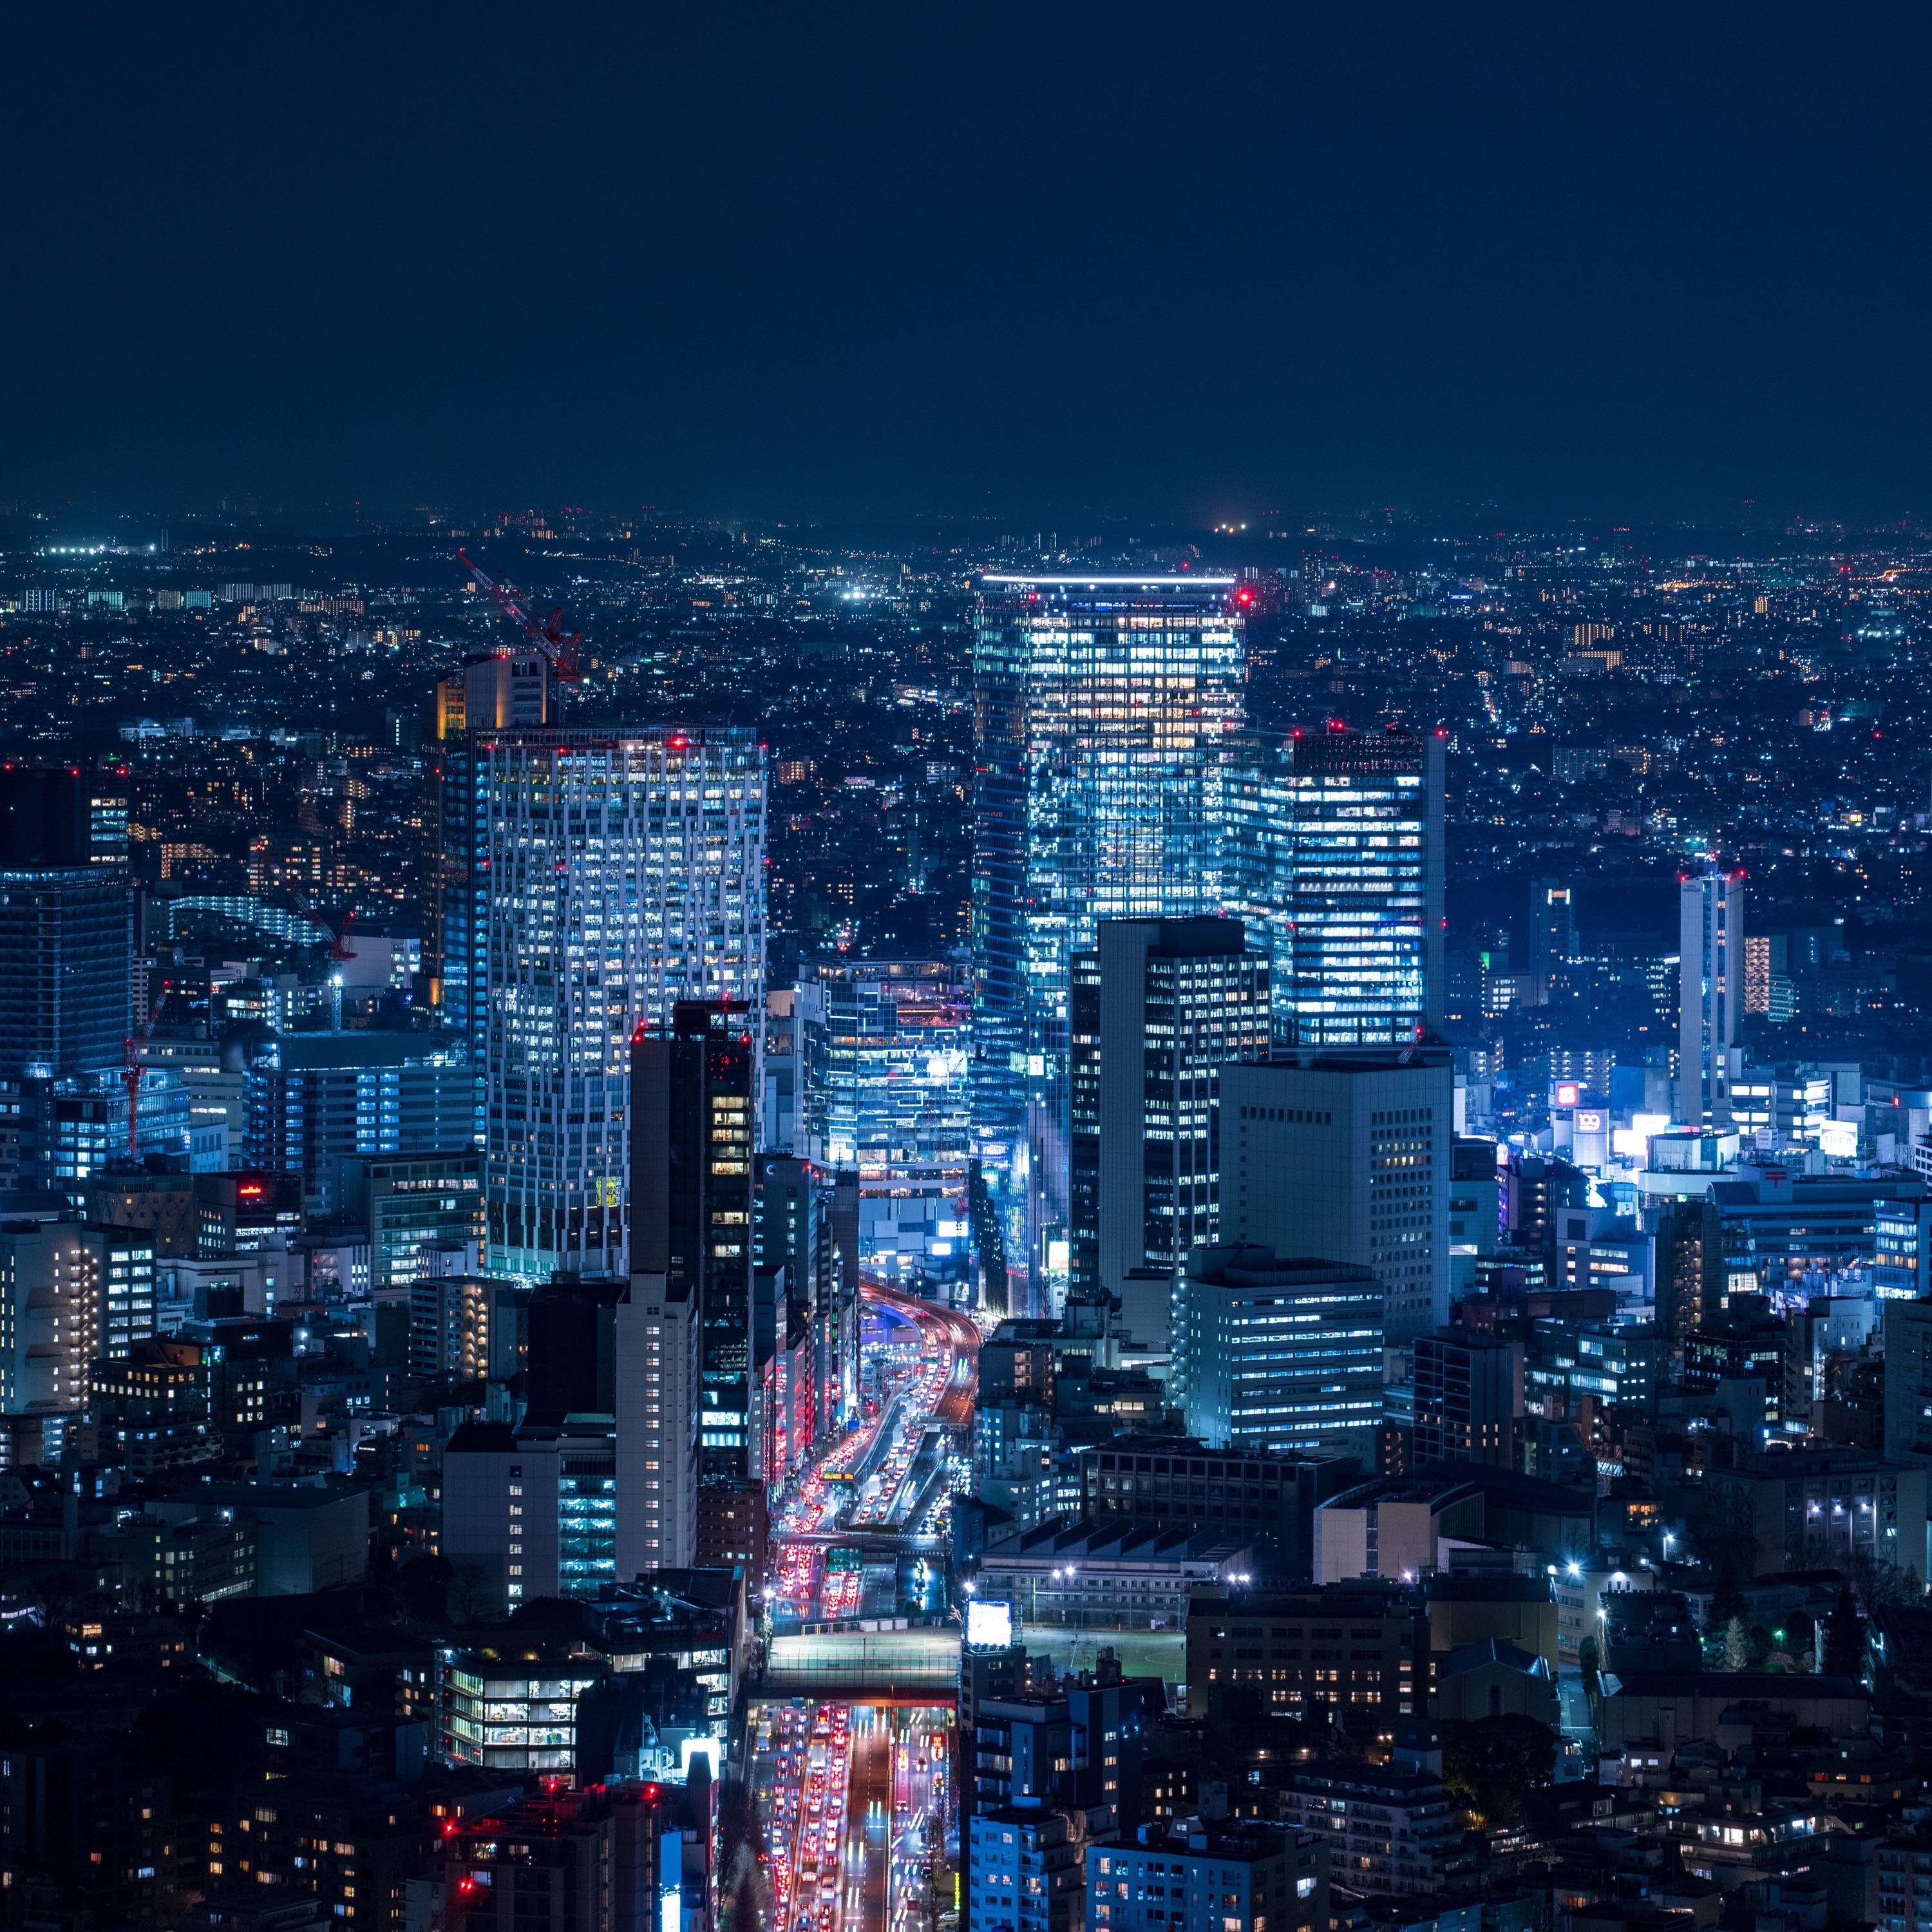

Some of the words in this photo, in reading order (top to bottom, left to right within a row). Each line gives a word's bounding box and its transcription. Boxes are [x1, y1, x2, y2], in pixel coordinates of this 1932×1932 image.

[1578, 1113, 1600, 1130] 109
[1825, 1135, 1852, 1145] IKEA
[860, 1162, 887, 1171] GMO
